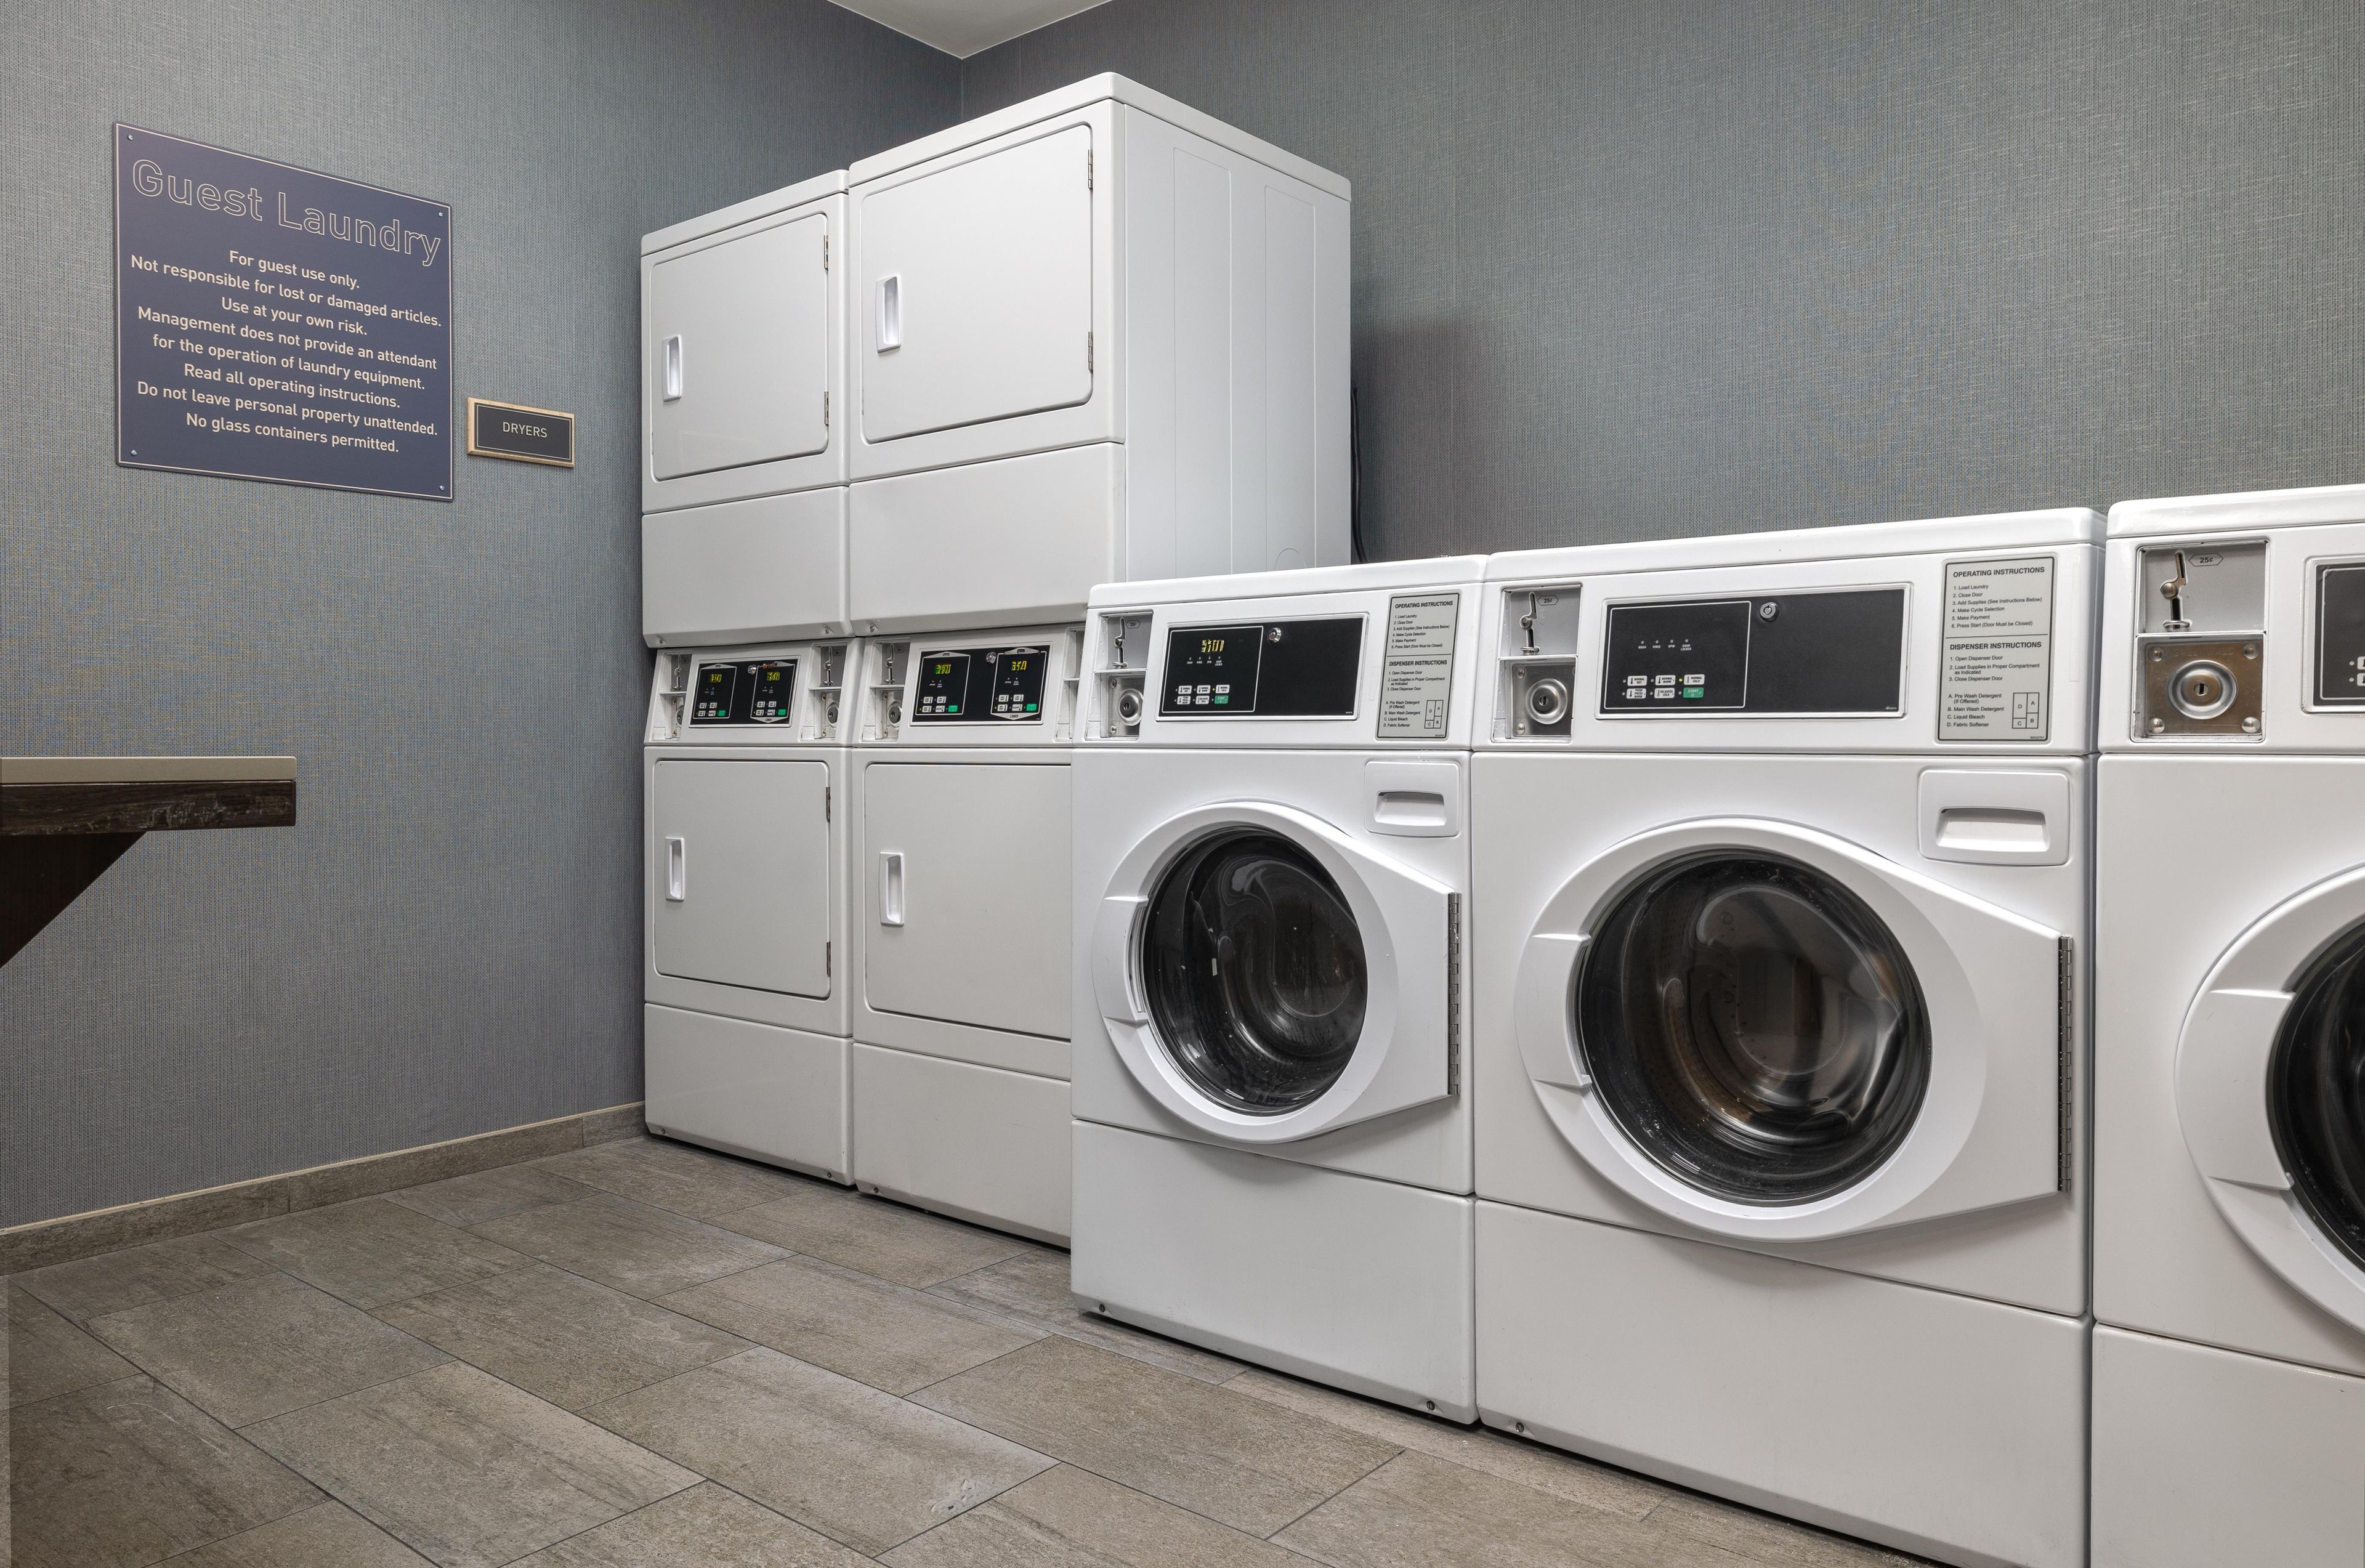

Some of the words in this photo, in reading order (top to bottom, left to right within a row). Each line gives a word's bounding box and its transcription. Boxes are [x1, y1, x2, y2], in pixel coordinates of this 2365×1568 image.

[133, 160, 262, 222] Guest
[278, 192, 441, 267] Laundry
[132, 255, 158, 273] Not
[164, 264, 250, 290] responsible
[254, 280, 275, 294] for
[280, 284, 304, 301] lost
[309, 293, 323, 304] or
[328, 294, 387, 317] damaged
[391, 309, 441, 326] articles.
[230, 250, 254, 267] For
[259, 260, 297, 276] guest
[302, 269, 325, 281] use
[329, 274, 360, 290] only.
[222, 297, 249, 313] Use
[253, 305, 267, 317] at
[271, 309, 302, 323] your
[306, 316, 334, 329] own
[339, 320, 367, 335] risk.
[139, 306, 236, 336] Management
[241, 325, 274, 342] does
[279, 334, 300, 346] not
[305, 339, 354, 355] provide
[358, 348, 373, 359] an
[378, 350, 437, 370] attendant
[153, 334, 176, 349] for
[179, 339, 203, 354] the
[209, 346, 277, 366] operation
[281, 357, 294, 368] of
[299, 358, 350, 380] laundry
[354, 370, 425, 390] equipment.
[185, 363, 221, 381] Read
[226, 371, 245, 385] all
[249, 377, 315, 398] operating
[320, 384, 400, 408] instructions.
[138, 381, 158, 396] Do
[163, 388, 187, 400] not
[192, 389, 230, 406] leave
[236, 398, 297, 416] personal
[302, 408, 360, 427] property
[364, 417, 437, 435] unattended.
[187, 413, 206, 427] No
[212, 417, 251, 433] glass
[255, 426, 328, 443] containers
[332, 435, 398, 453] permitted.
[503, 422, 547, 438] DRYERS
[1953, 570, 1992, 578] OPERATING
[1994, 567, 2045, 575] INSTRUCTIONS
[1990, 641, 2042, 649] INSTRUCTIONS
